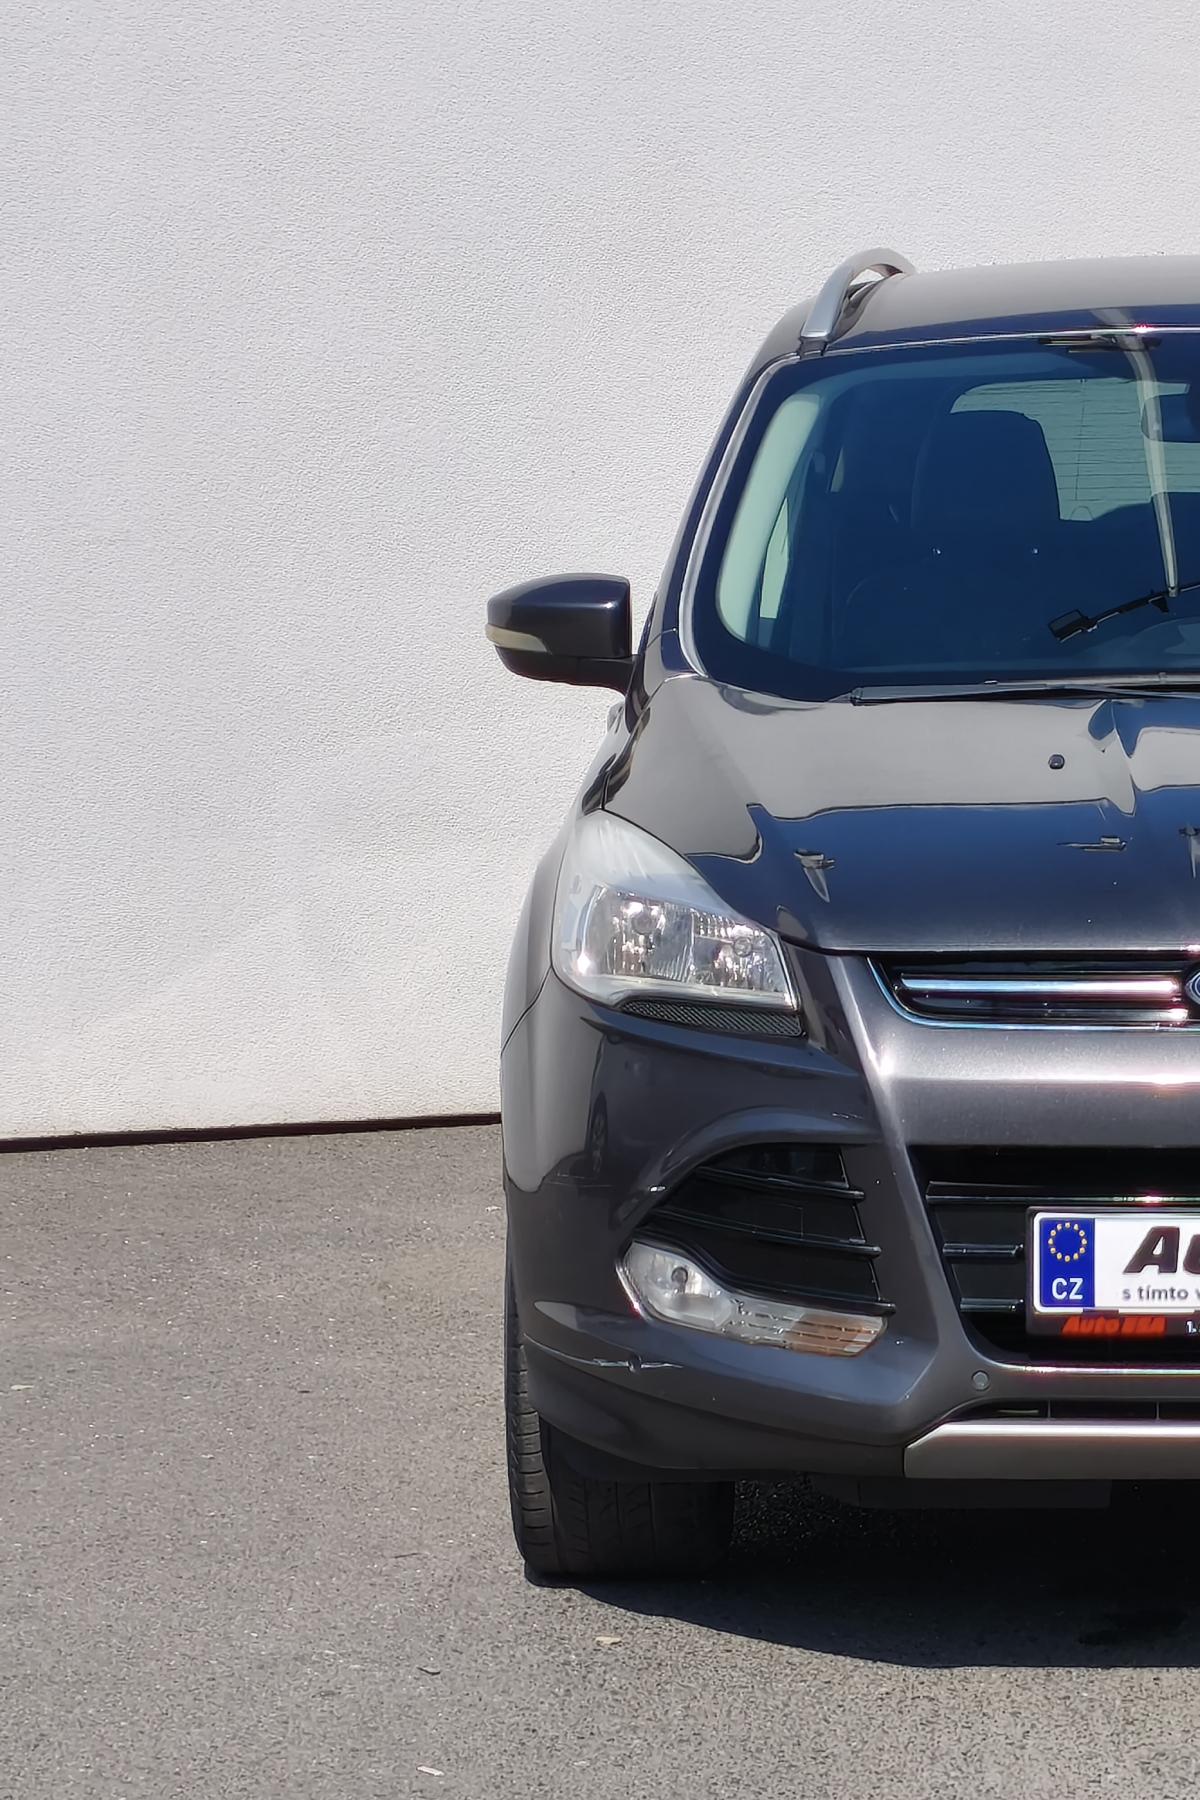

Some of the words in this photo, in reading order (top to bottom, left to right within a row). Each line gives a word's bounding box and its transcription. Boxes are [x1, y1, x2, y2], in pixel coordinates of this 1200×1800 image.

[1051, 1277, 1083, 1300] CZ
[1122, 1287, 1132, 1300] s
[1137, 1284, 1189, 1300] tímto
[1186, 1320, 1197, 1333] 1.
